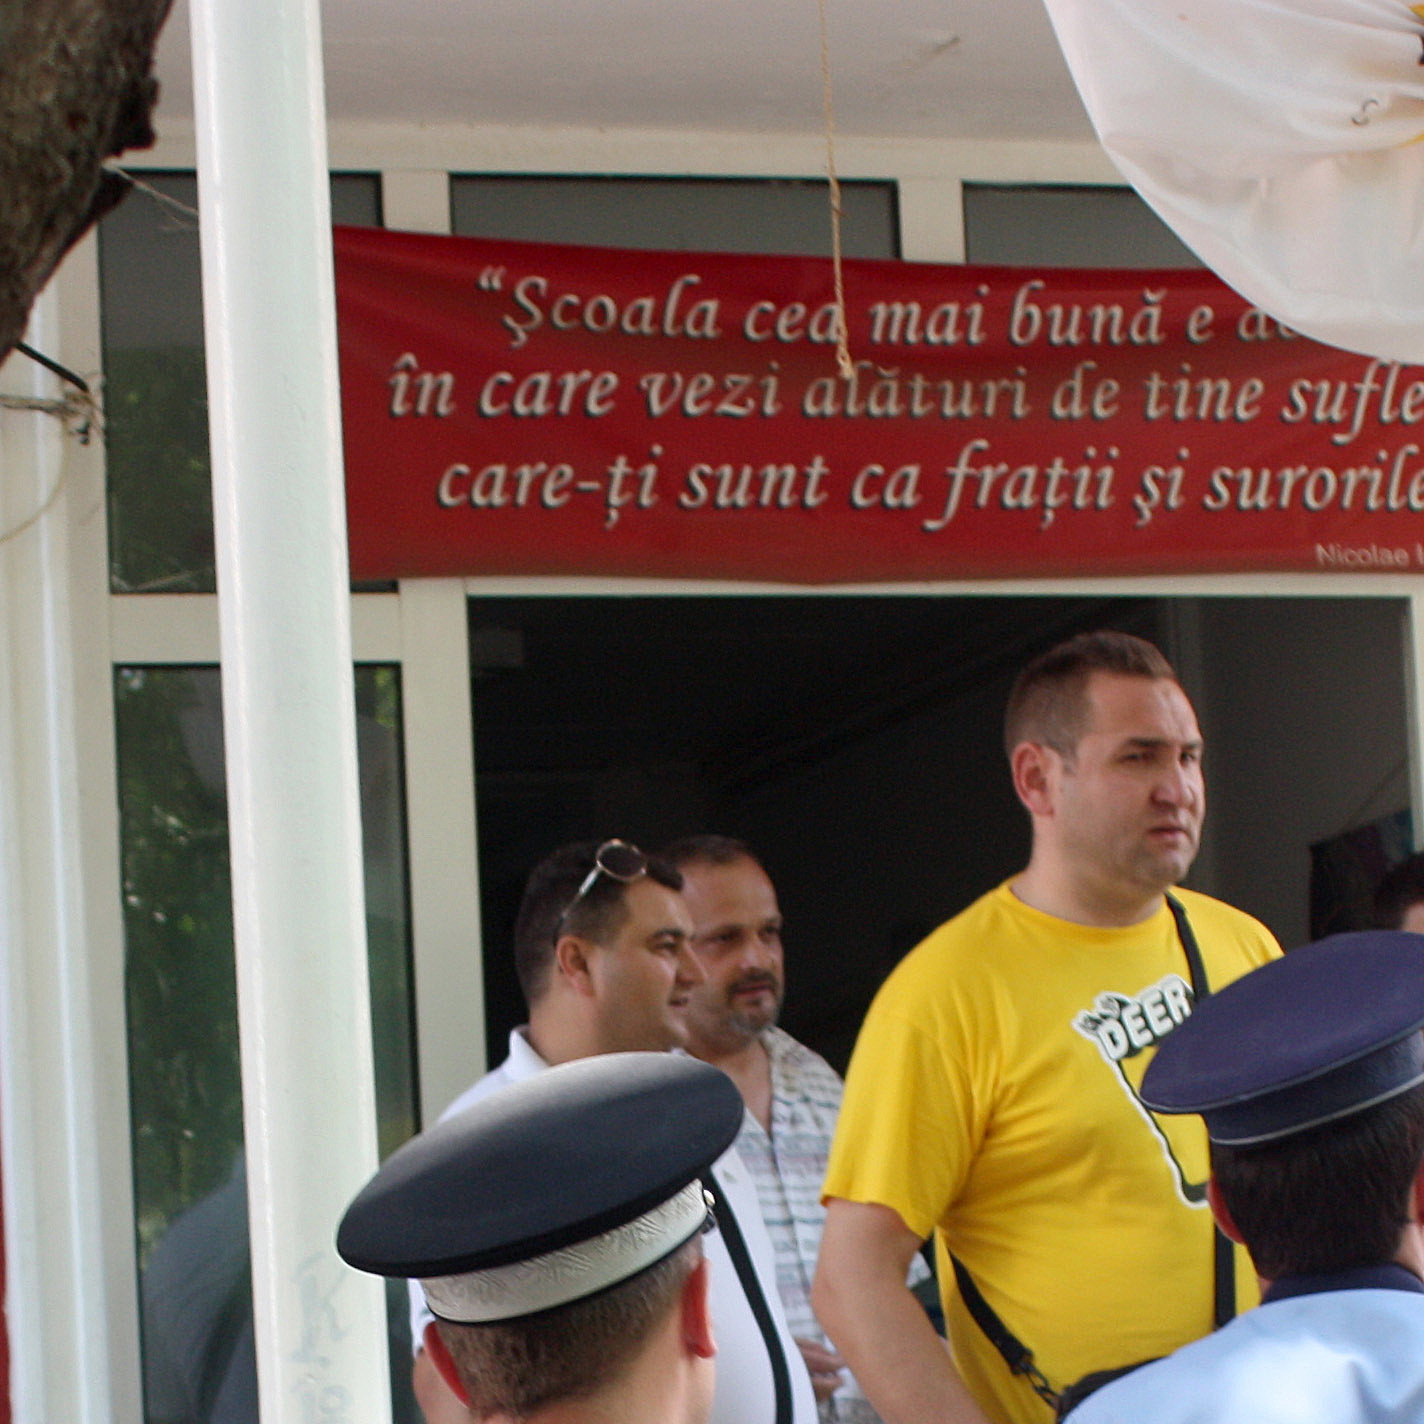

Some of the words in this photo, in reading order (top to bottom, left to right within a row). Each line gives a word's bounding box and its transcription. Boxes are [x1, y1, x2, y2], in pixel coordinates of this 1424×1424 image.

[744, 298, 844, 343] cea
[871, 284, 989, 345] mai
[1011, 281, 1165, 346] bună
[1187, 304, 1214, 343] e
[389, 353, 455, 417] în
[480, 369, 619, 416] care
[639, 361, 779, 417] vezi
[803, 360, 1030, 418] alături
[1051, 362, 1120, 419] de
[1145, 363, 1264, 421] tine
[680, 455, 829, 508] sunt
[851, 463, 921, 508] ca
[1315, 543, 1410, 568] Nicolae
[1097, 974, 1194, 1062] DEER
